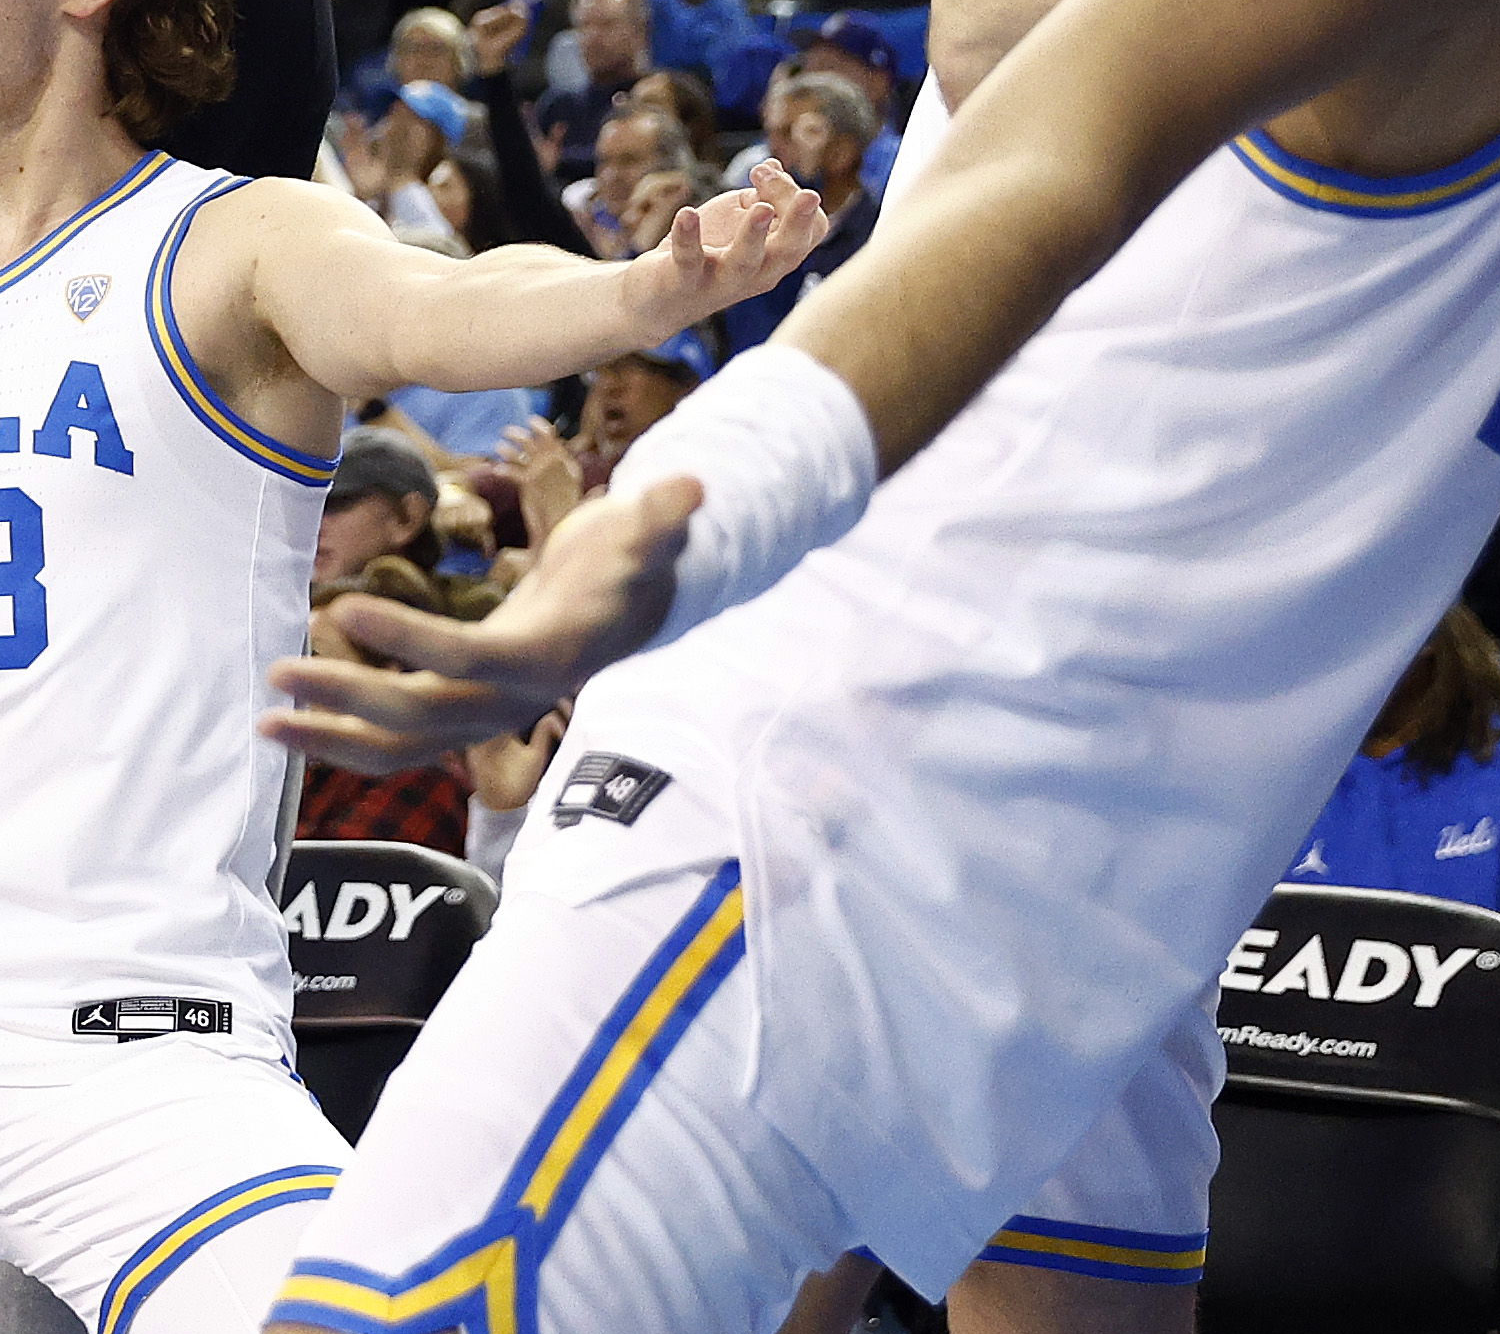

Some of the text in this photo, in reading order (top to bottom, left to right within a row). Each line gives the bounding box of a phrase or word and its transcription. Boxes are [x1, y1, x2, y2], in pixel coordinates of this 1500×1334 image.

[282, 880, 448, 942] ADY
[1219, 928, 1481, 1008] EADY
[184, 1008, 210, 1028] 46
